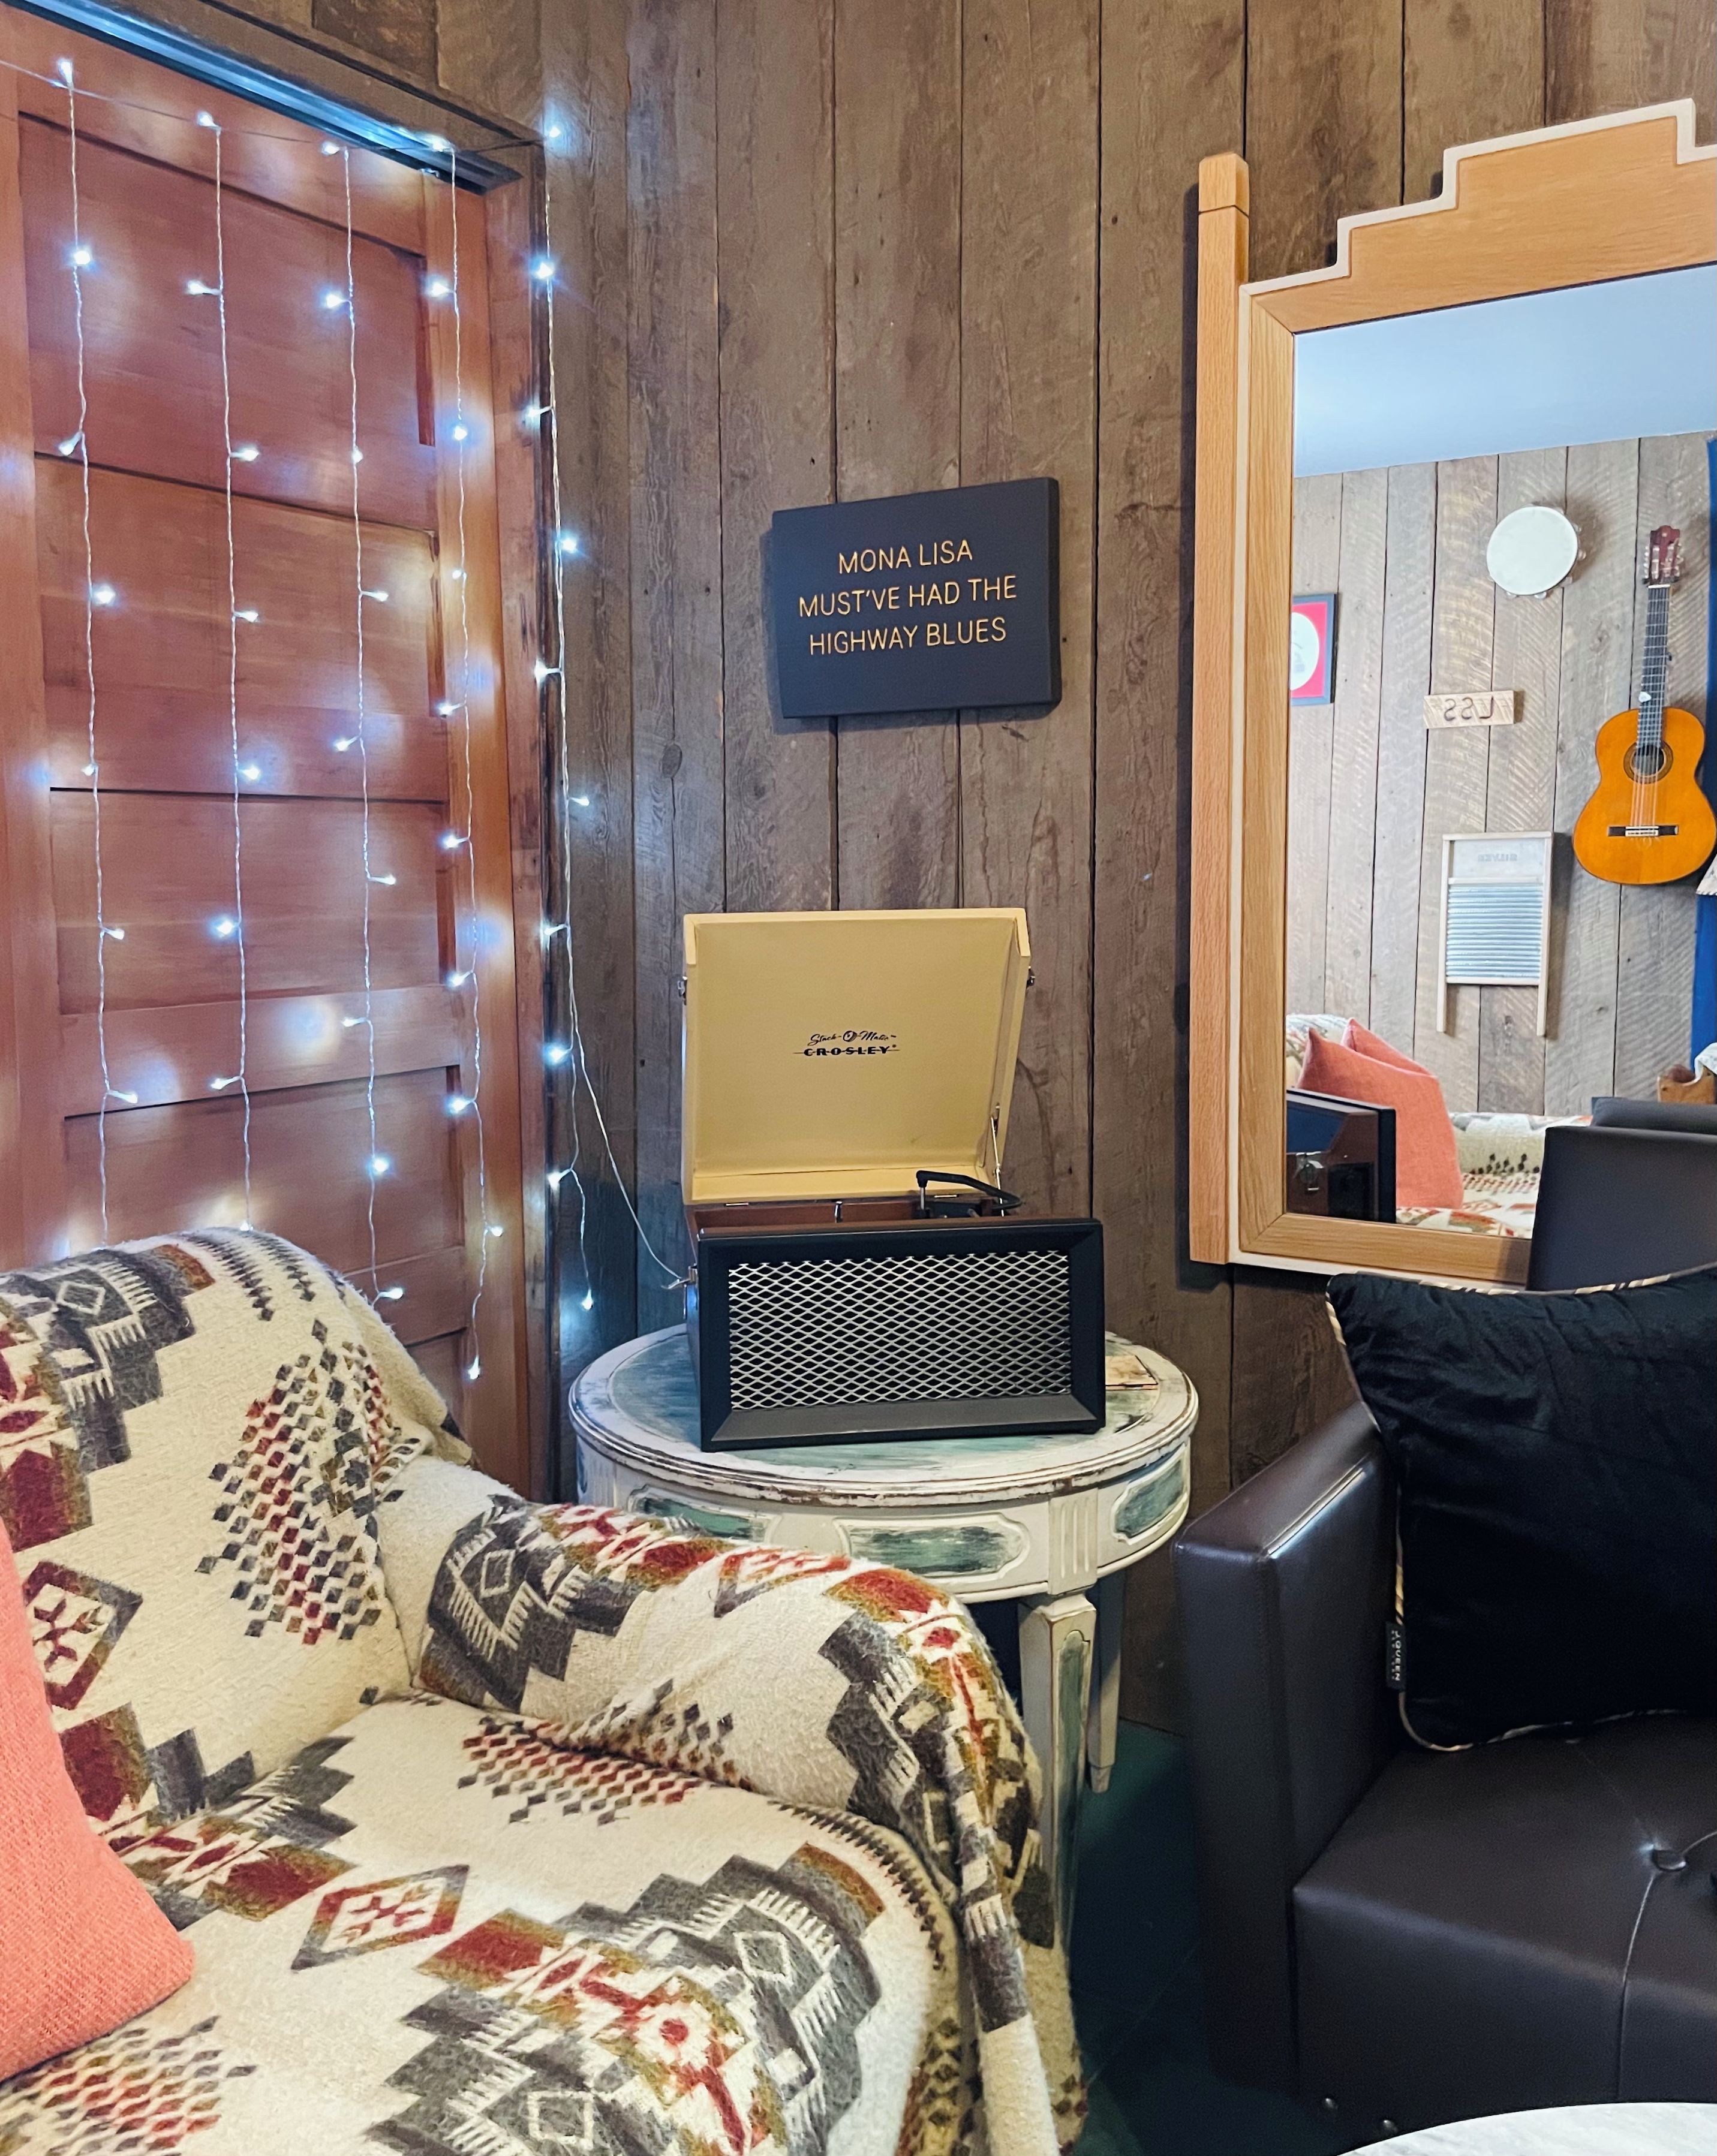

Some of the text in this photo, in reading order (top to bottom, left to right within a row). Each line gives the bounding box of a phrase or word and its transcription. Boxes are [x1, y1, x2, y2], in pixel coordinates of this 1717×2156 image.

[839, 540, 973, 574] MONA LISA
[799, 575, 1017, 618] MUST'VE HAD THE
[810, 617, 1007, 655] HIGHWAY BLUES
[804, 1046, 890, 1056] CROSLEY
